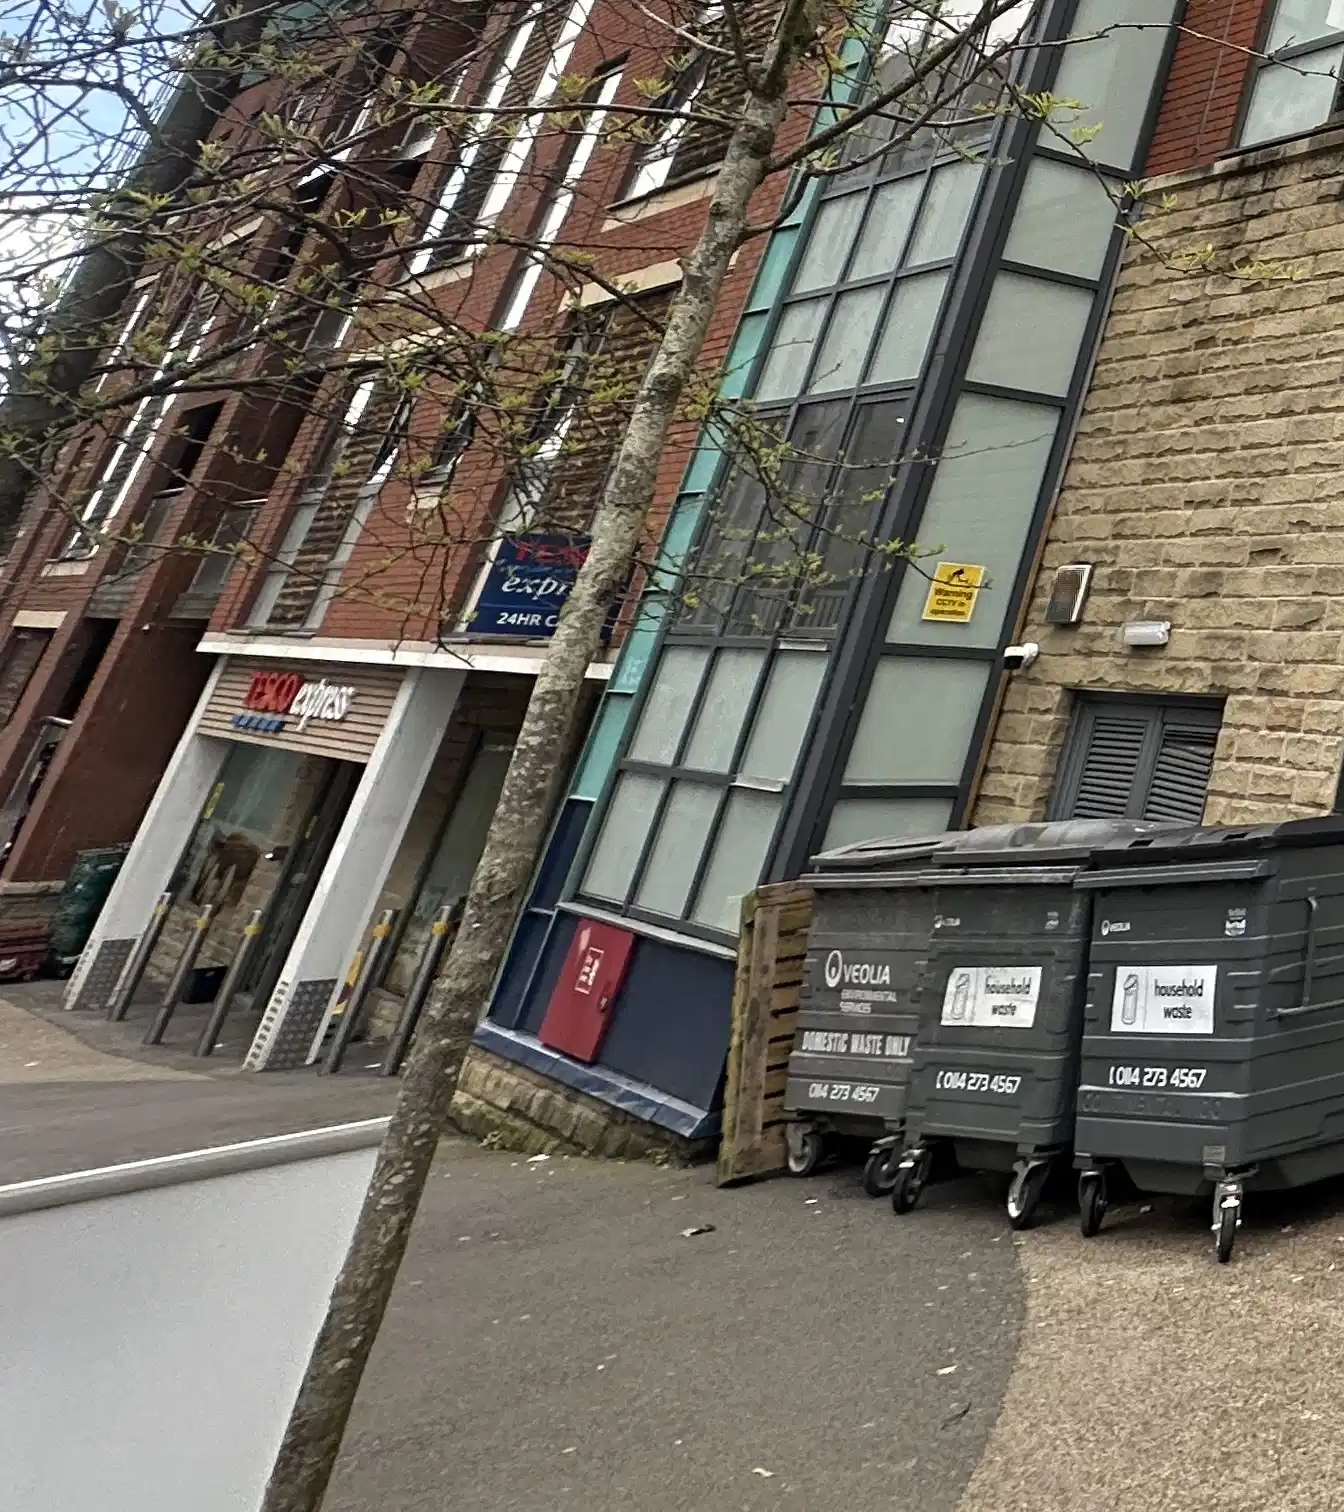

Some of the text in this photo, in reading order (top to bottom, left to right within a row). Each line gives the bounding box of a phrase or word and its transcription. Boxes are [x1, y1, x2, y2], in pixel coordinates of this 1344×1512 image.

[502, 576, 574, 600] expr
[496, 612, 541, 627] 24HR
[243, 671, 356, 731] TESCO express
[843, 963, 891, 985] VEOLIA
[984, 974, 1033, 995] household
[1154, 978, 1205, 997] household
[992, 1002, 1017, 1016] waste
[1163, 1004, 1193, 1019] waste
[802, 1031, 912, 1057] DOMESTIC WASTE ONLY
[967, 1072, 989, 1092] 273
[990, 1075, 1022, 1094] 4567
[1143, 1066, 1167, 1087] 273
[1170, 1068, 1207, 1088] 4567
[830, 1084, 851, 1101] 273
[852, 1086, 880, 1103] 4567
